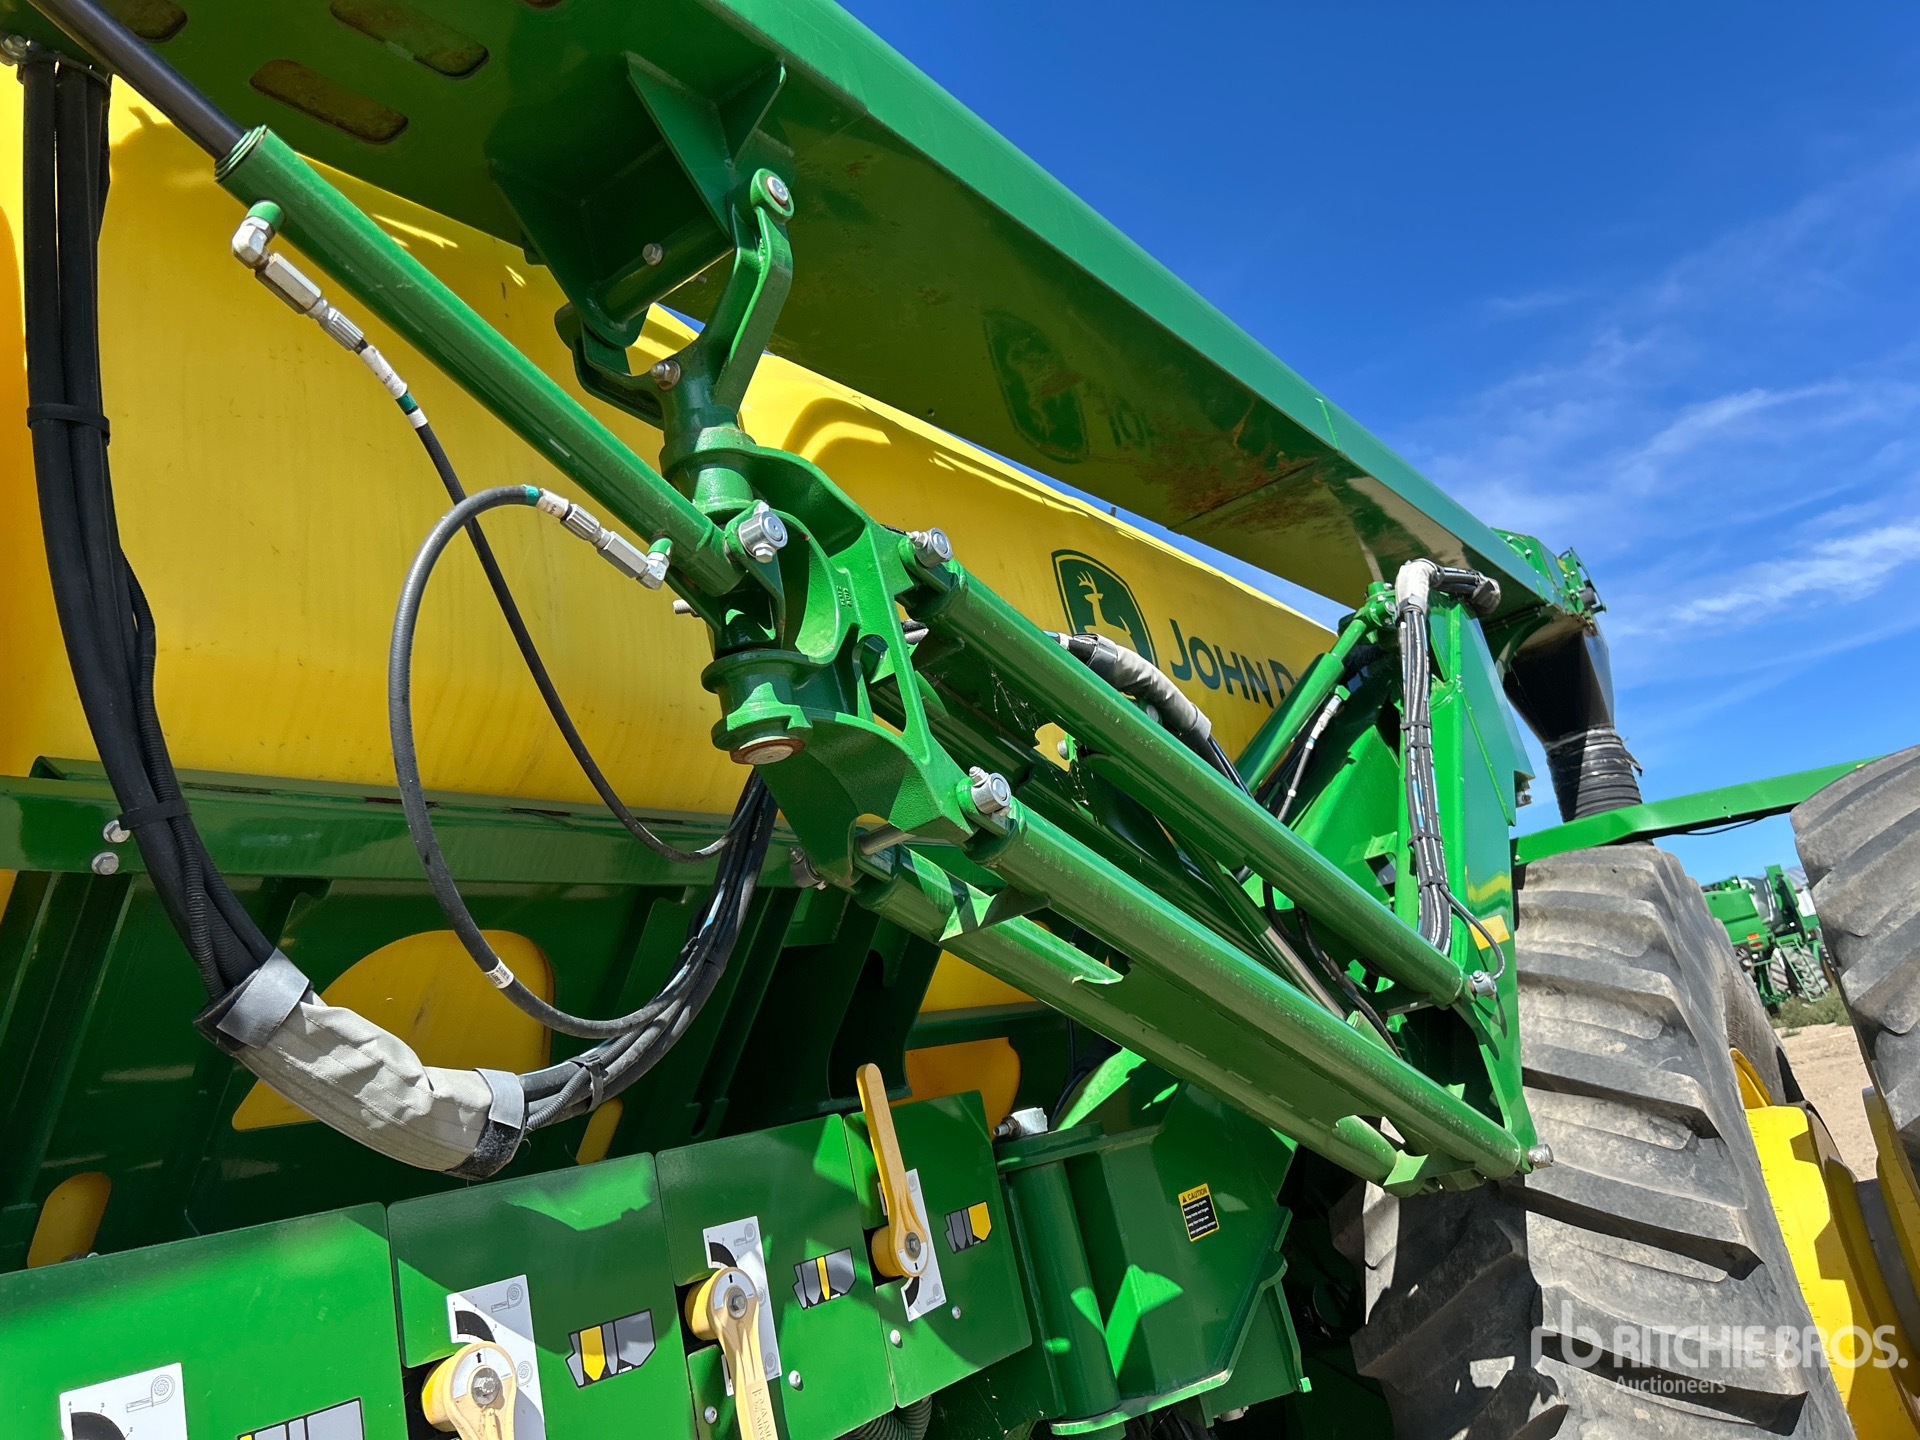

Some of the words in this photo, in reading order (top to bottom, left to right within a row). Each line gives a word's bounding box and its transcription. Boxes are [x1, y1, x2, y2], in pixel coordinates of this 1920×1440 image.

[1169, 618, 1275, 708] JOHN
[1267, 658, 1299, 701] D
[1187, 1187, 1208, 1201] CAUTION
